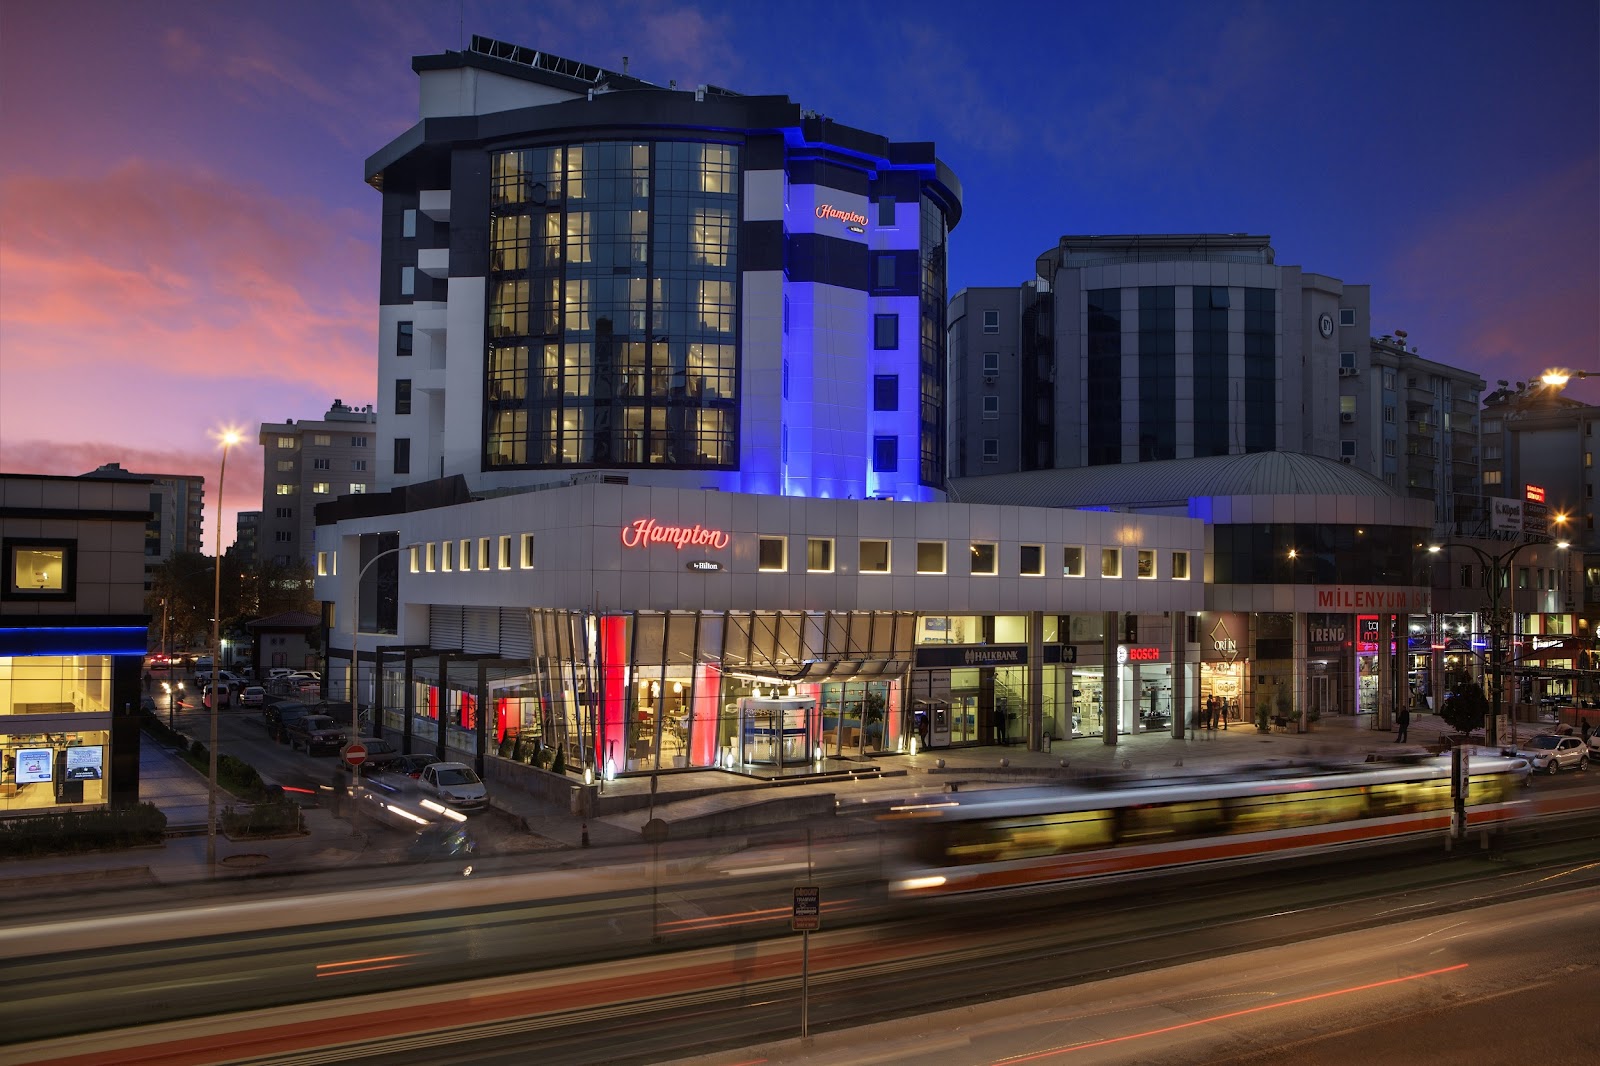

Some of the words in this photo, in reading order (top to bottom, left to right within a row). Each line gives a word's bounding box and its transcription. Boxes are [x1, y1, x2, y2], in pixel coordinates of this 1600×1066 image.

[815, 204, 869, 226] Hampton
[622, 518, 729, 549] Hampton
[1318, 588, 1407, 608] MİLENYUM
[1309, 628, 1345, 642] TREND
[975, 651, 1018, 661] HALKBANK
[1130, 648, 1159, 660] BOSCH
